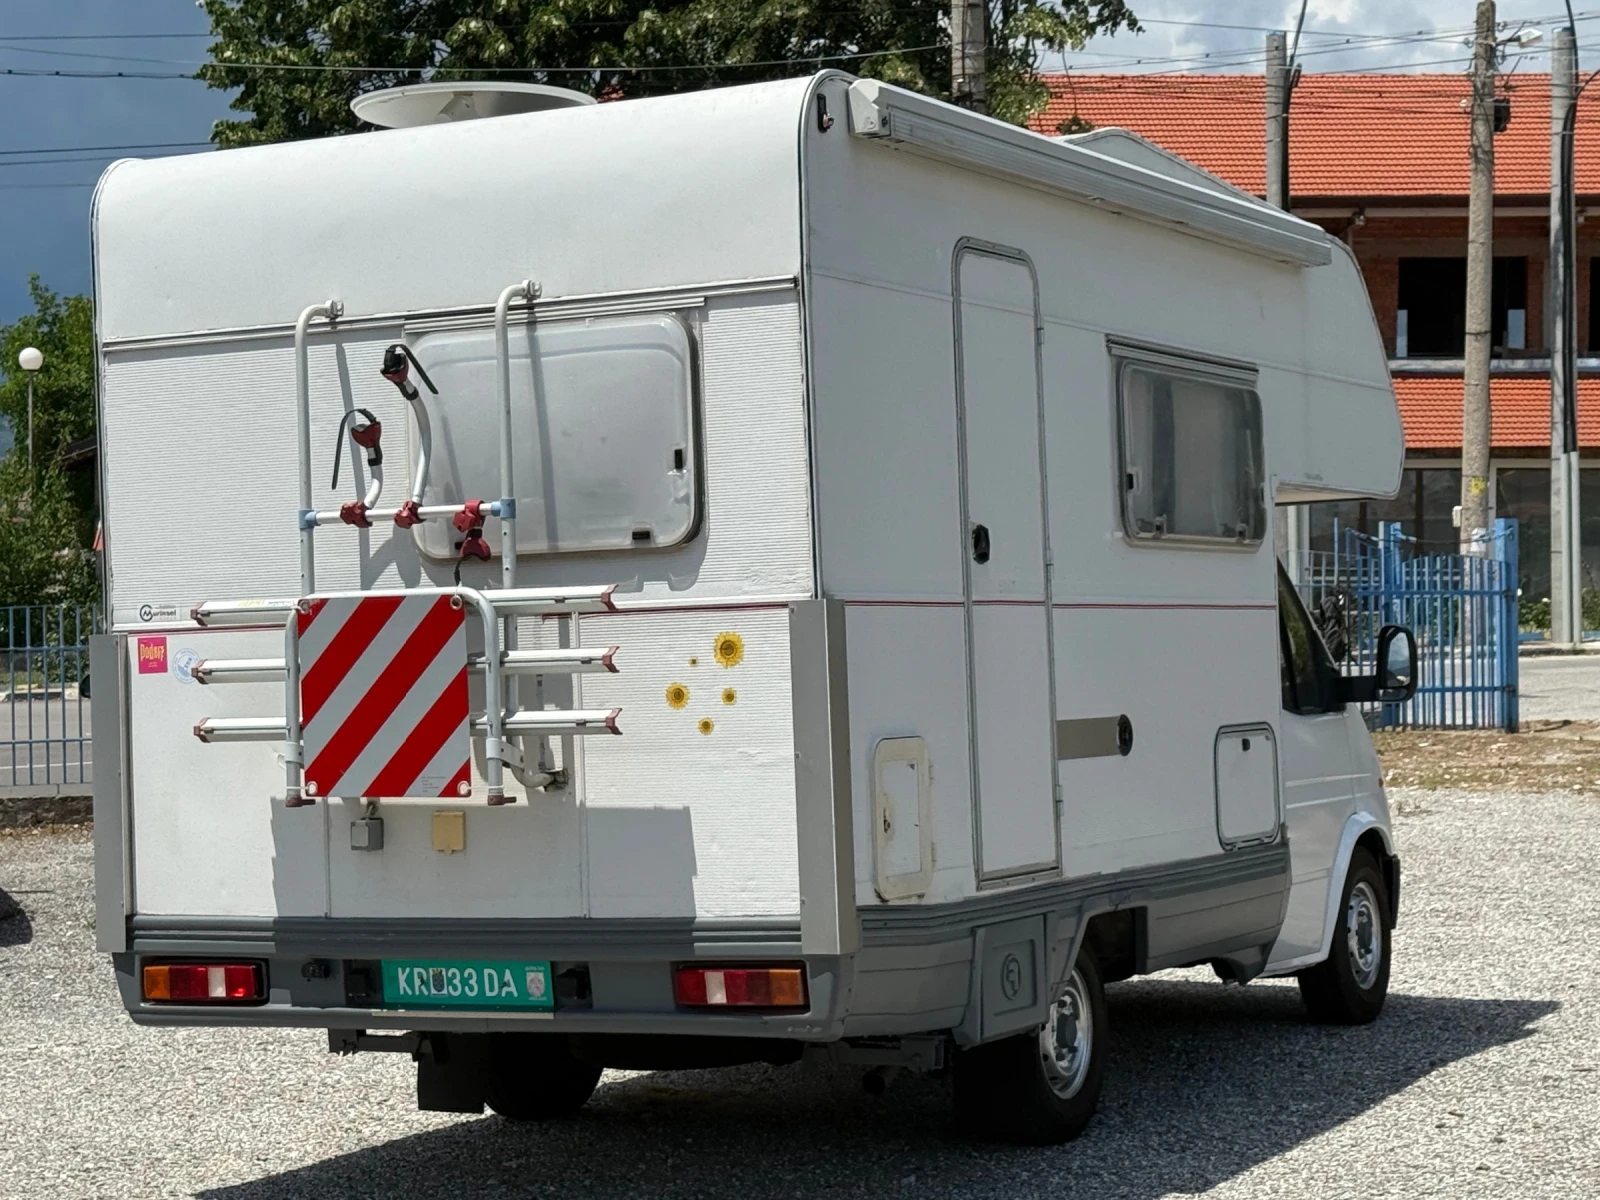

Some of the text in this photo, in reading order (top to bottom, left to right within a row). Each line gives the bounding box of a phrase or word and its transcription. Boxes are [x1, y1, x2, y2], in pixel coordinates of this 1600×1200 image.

[398, 967, 519, 998] KR 33 DA
